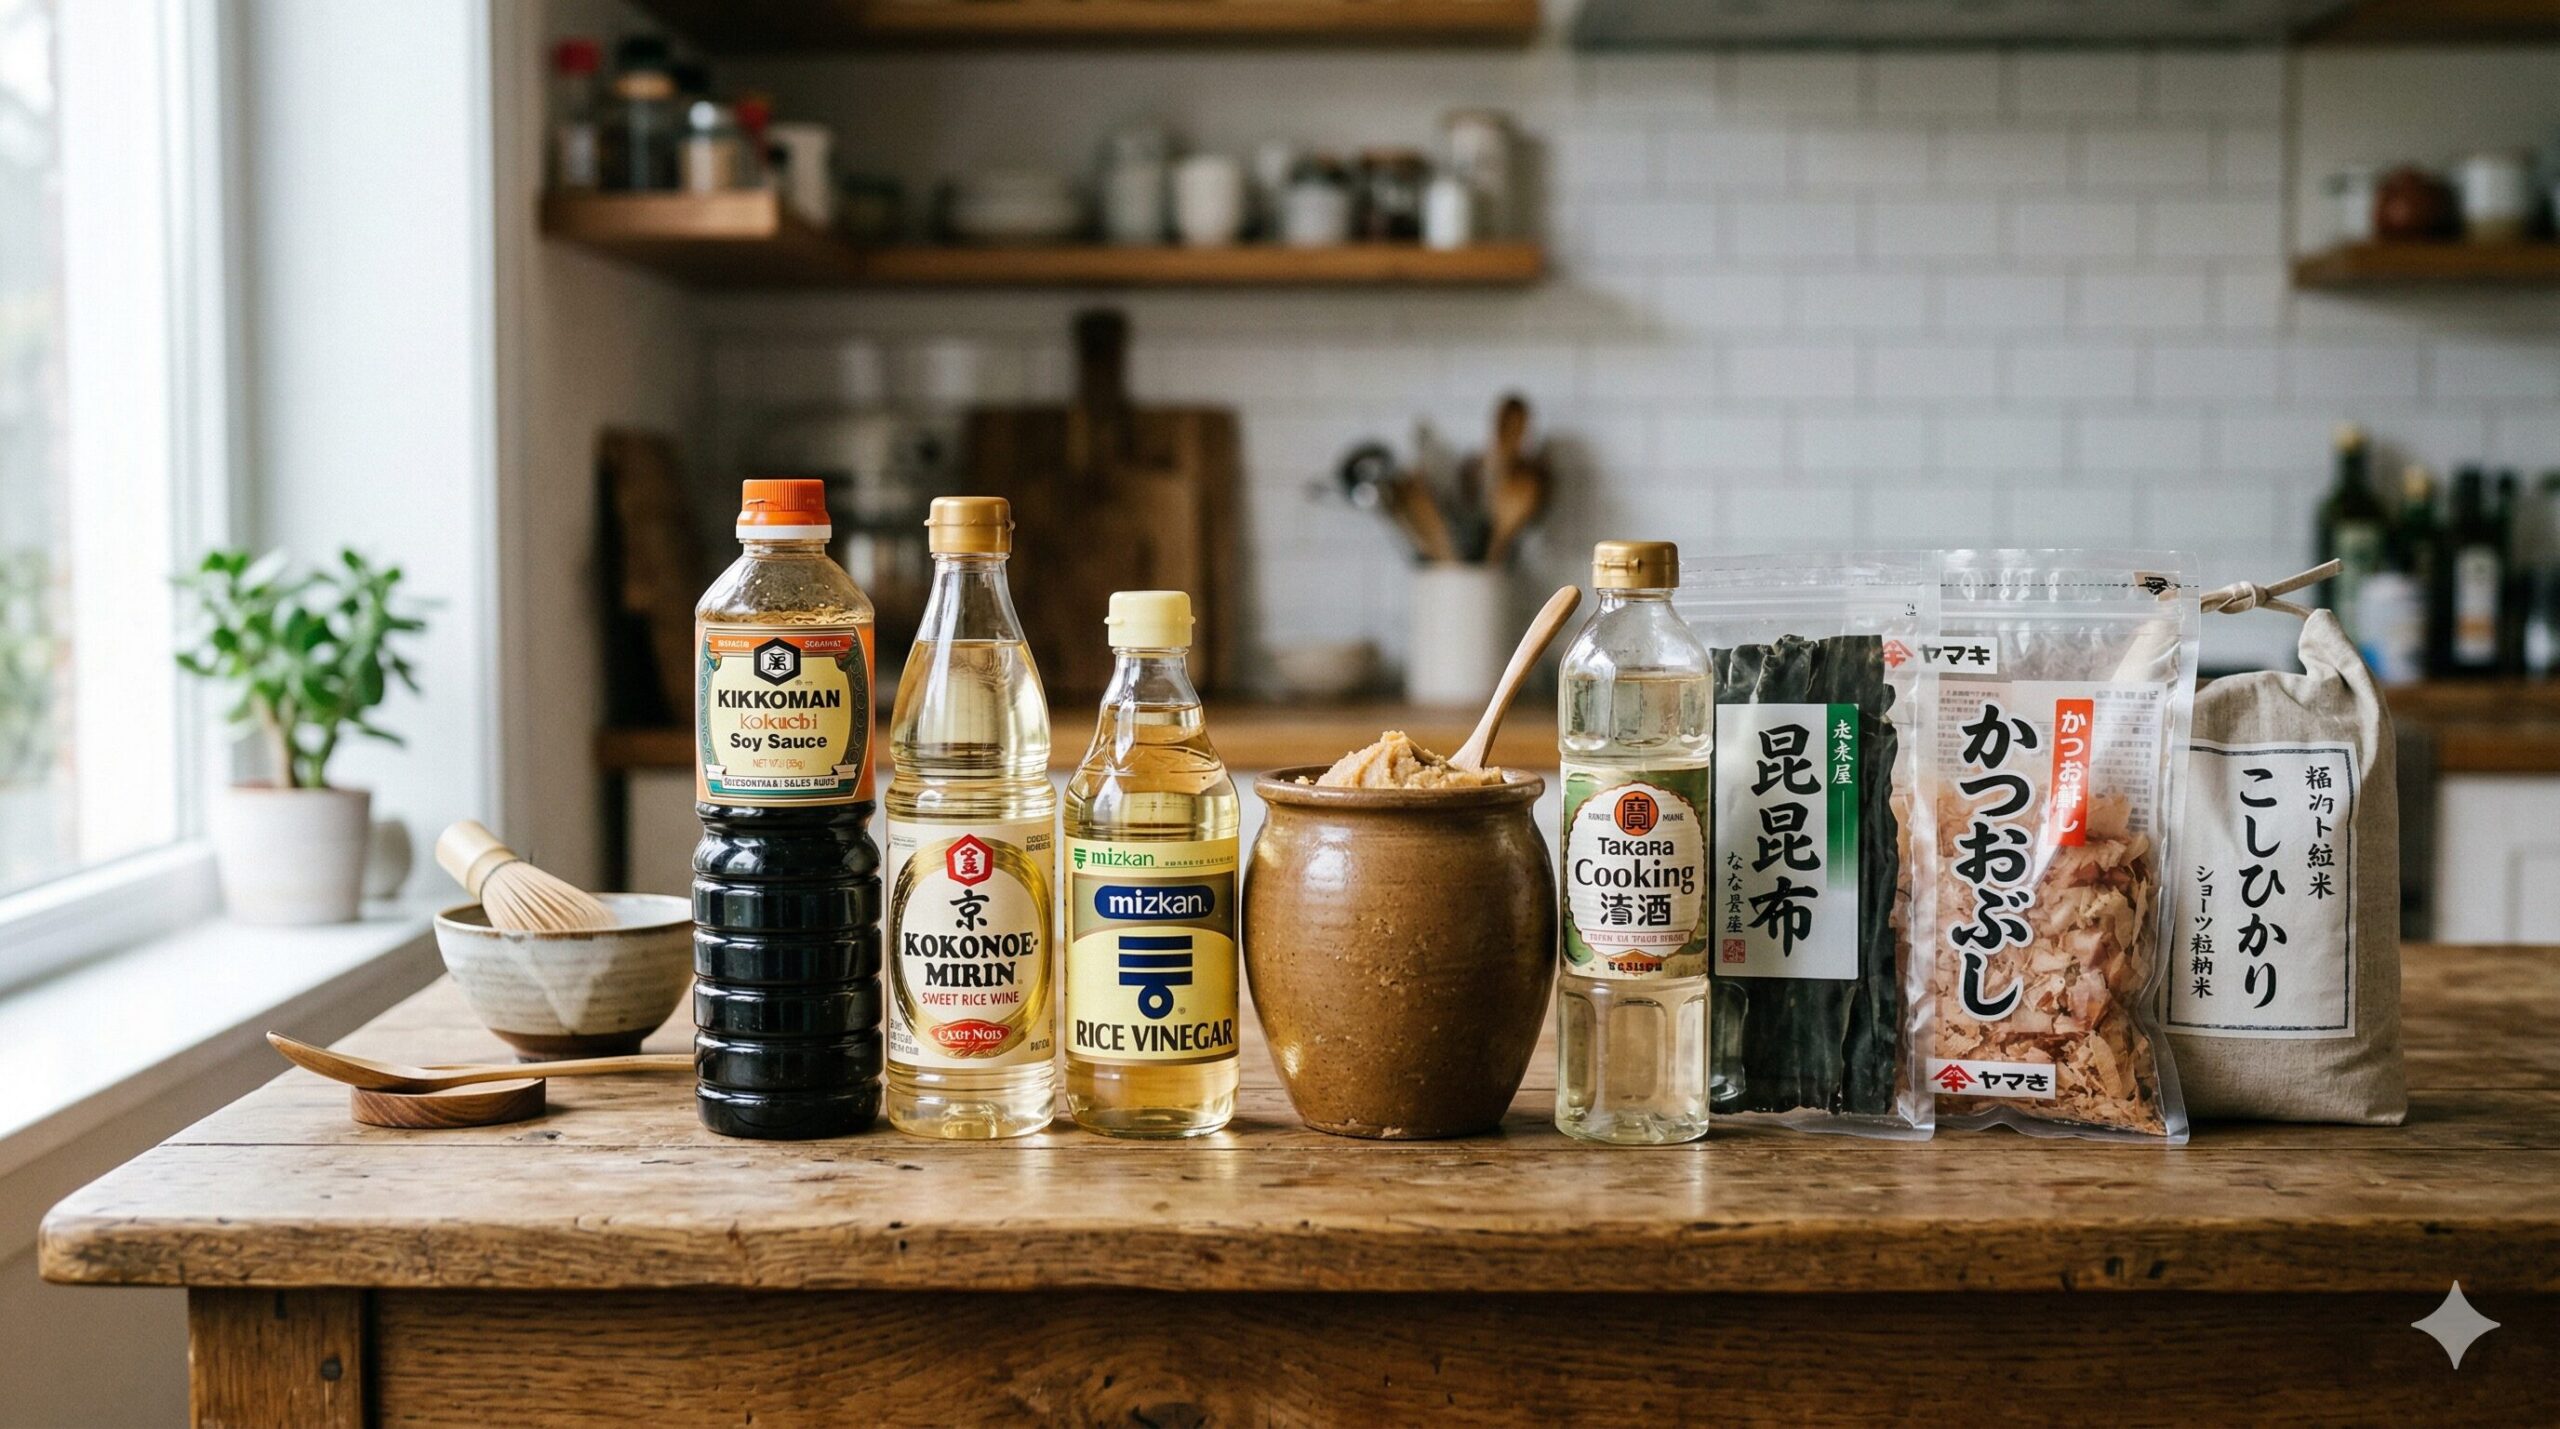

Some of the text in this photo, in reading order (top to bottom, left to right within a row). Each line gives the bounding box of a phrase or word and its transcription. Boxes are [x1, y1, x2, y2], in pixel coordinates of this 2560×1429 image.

[1918, 644, 1991, 666] ヤマキ
[718, 689, 840, 709] KIKKOMAN
[730, 733, 828, 752] Soy Sauce
[1747, 723, 1822, 958] 昆昆布
[1092, 847, 1155, 867] mizkan
[1952, 703, 2038, 1017] かつおぶし
[1575, 858, 1695, 895] Cooking
[2238, 768, 2288, 1009] こしひかり
[949, 889, 990, 931] 京
[925, 961, 1017, 988] MIRIN
[922, 991, 1020, 1006] SWEET RICE WINE
[1076, 1019, 1125, 1051] RICE
[1131, 1018, 1233, 1052] VINEGAR
